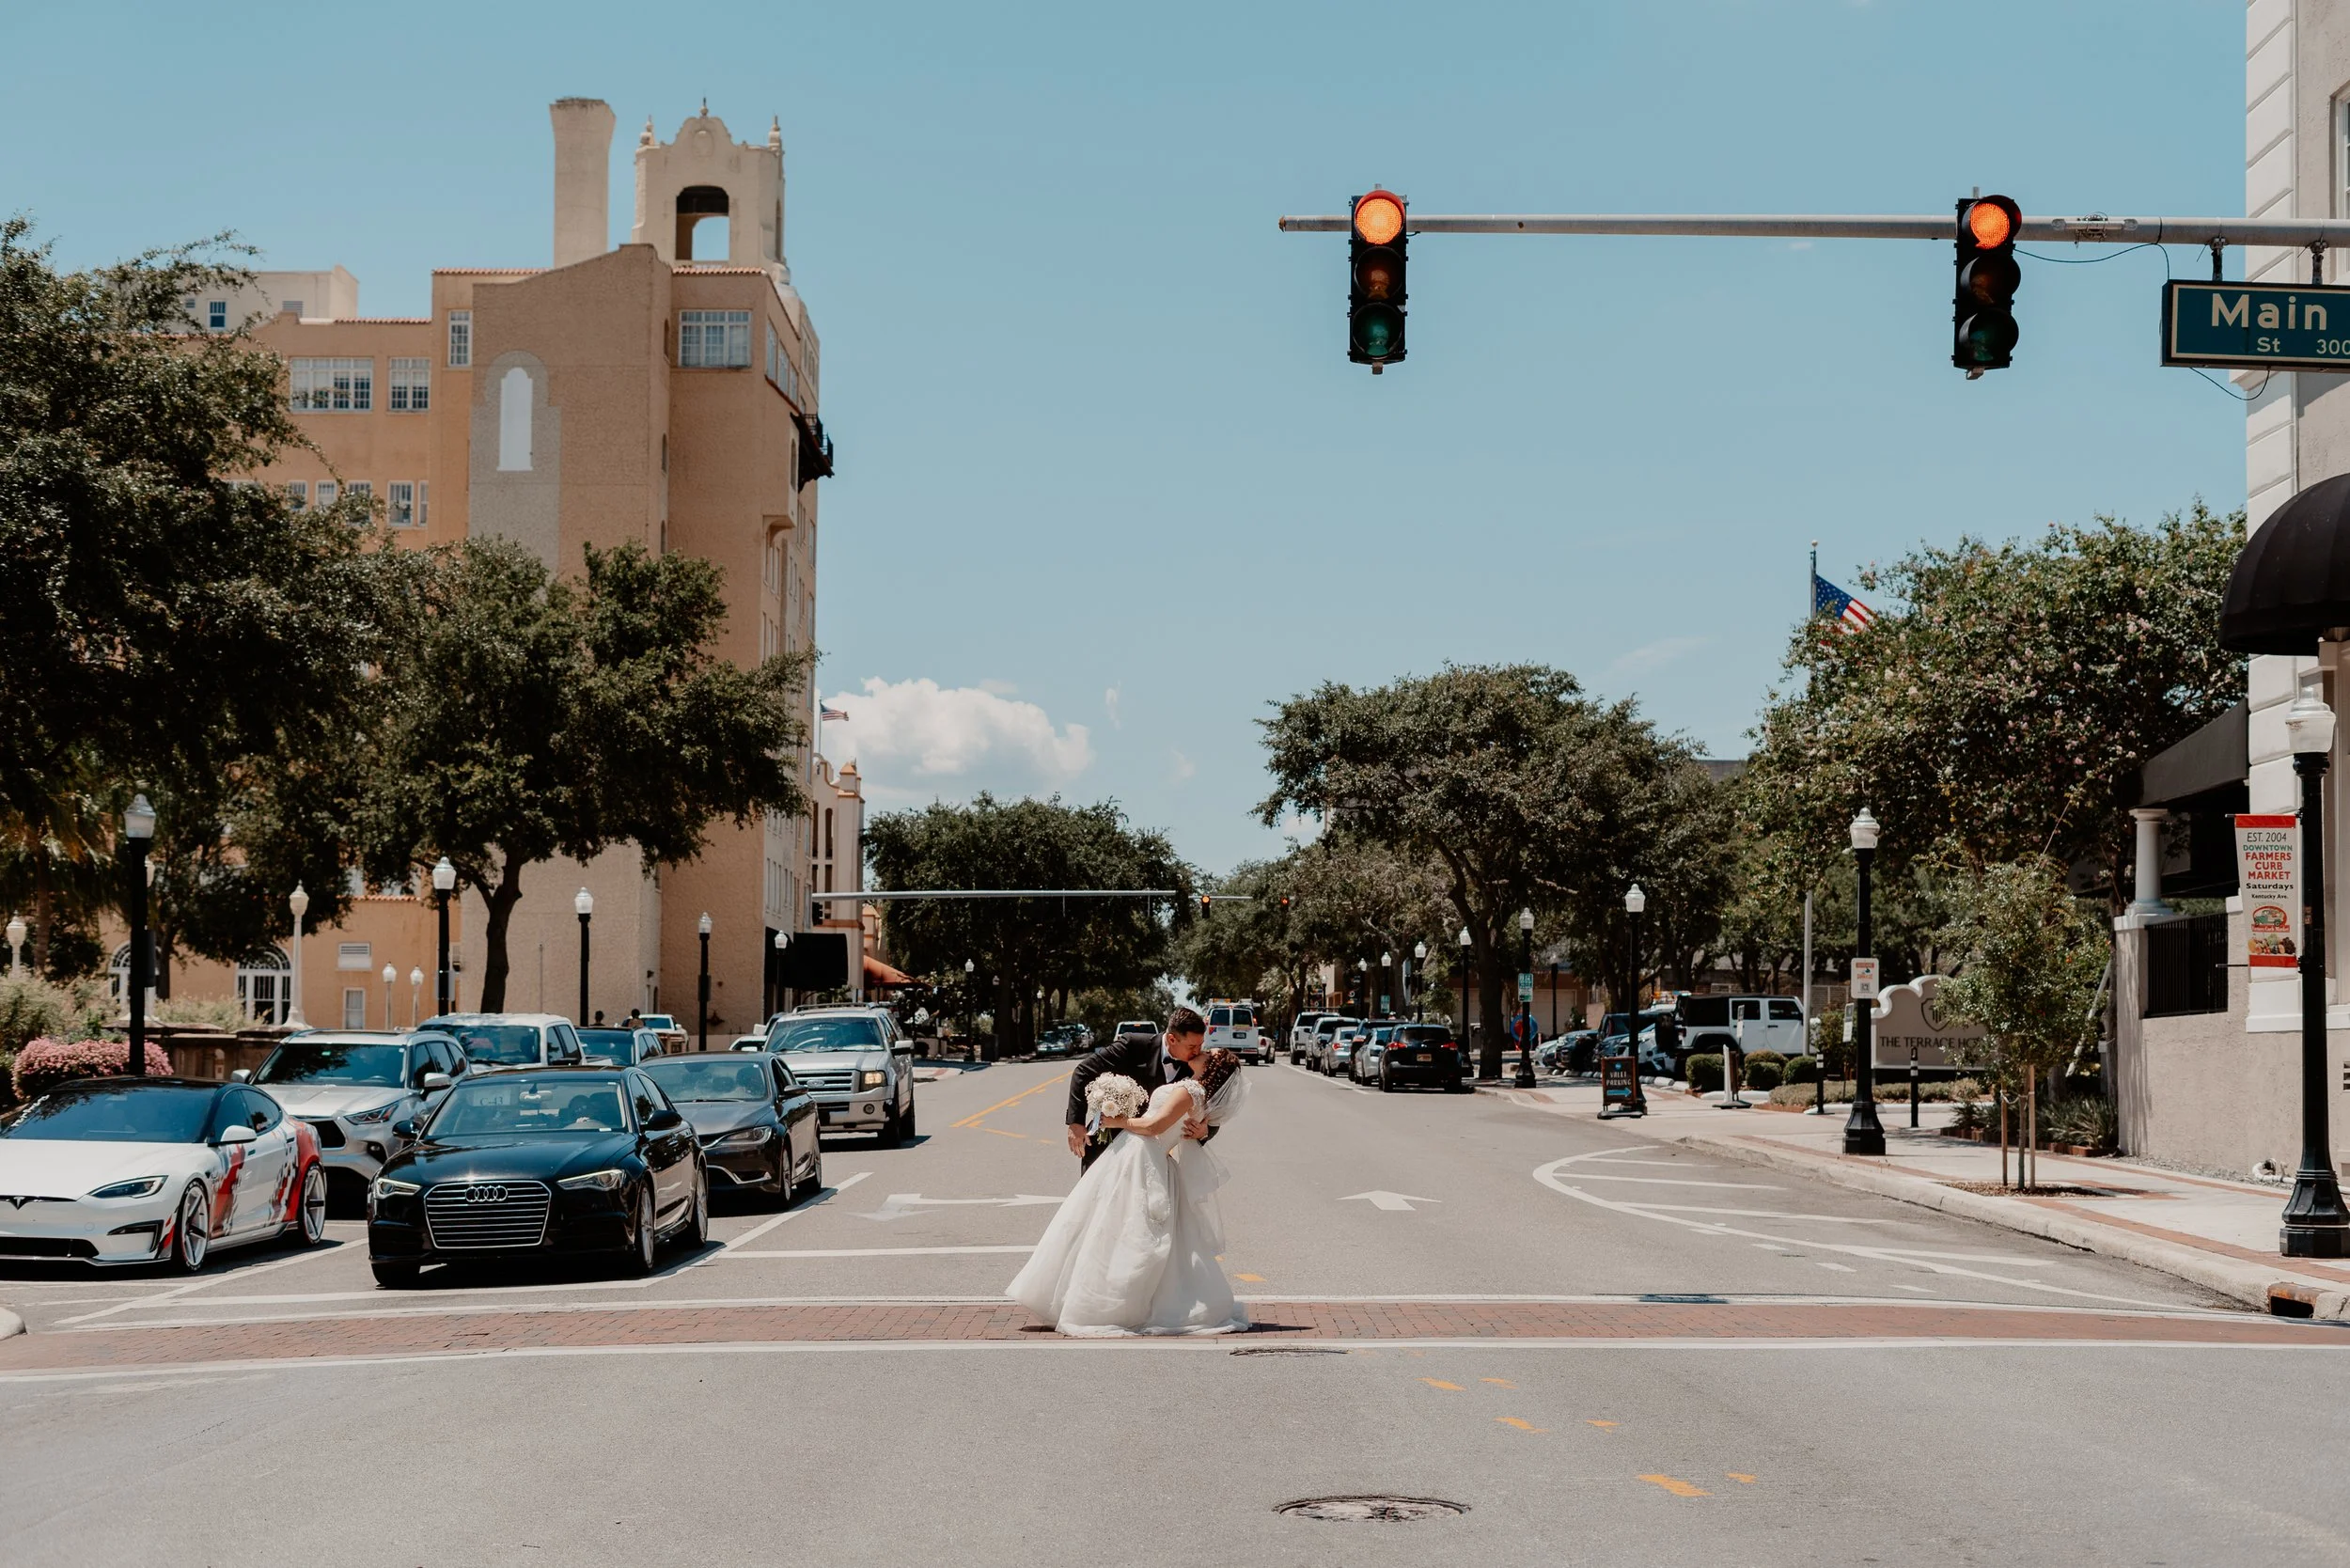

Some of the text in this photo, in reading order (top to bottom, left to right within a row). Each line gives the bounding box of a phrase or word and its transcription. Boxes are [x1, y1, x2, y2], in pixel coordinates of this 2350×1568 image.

[2212, 293, 2326, 330] Main
[2257, 337, 2350, 355] St 300
[2247, 832, 2287, 842] EST. 2004
[2245, 852, 2292, 860] FARMERS
[2255, 861, 2283, 870] CURB
[2248, 870, 2291, 880] MARKET
[1879, 1036, 1901, 1047] THE
[1904, 1036, 1955, 1048] TERRACE
